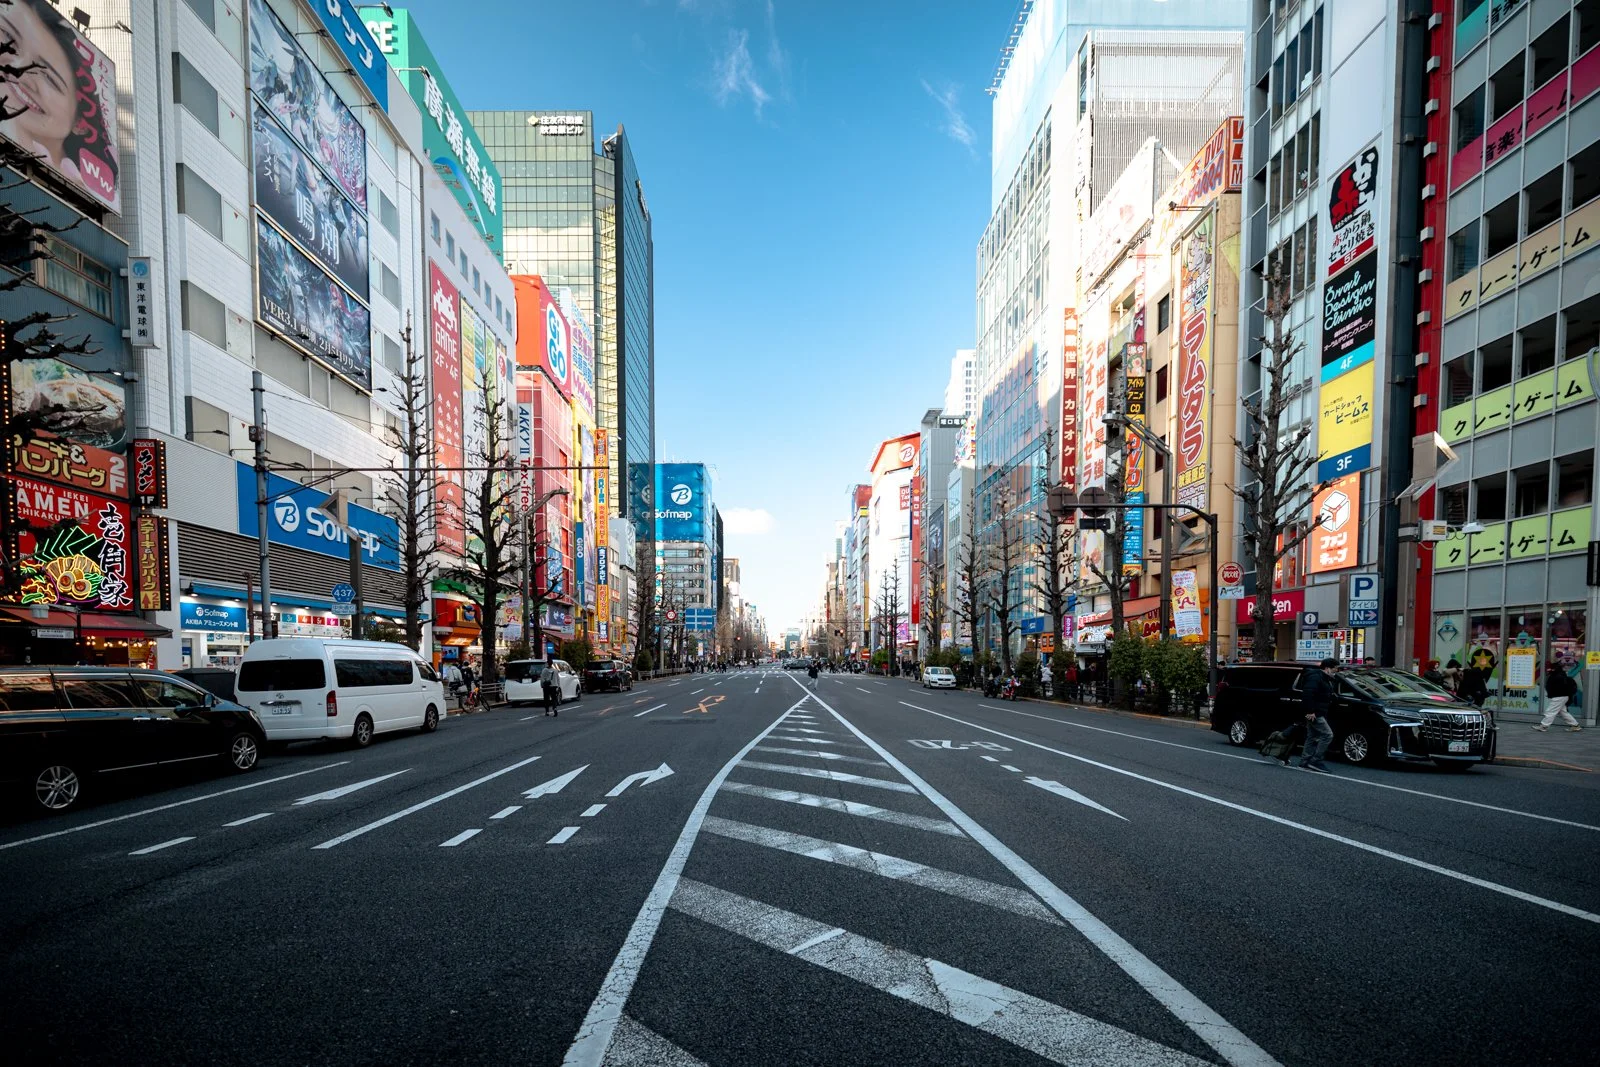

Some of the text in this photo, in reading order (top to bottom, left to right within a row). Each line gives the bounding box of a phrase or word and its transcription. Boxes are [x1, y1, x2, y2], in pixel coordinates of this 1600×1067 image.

[366, 20, 393, 53] SE
[540, 116, 583, 125] 住友不動産
[1480, 88, 1575, 162] 音楽ゲーム
[423, 75, 497, 216] 廣瀬無線
[1204, 128, 1224, 169] DVD
[1332, 209, 1371, 249] 赤から鍋
[1328, 222, 1375, 262] セセリ焼き
[1343, 248, 1357, 265] 5F
[1459, 226, 1591, 307] クレーンゲーム
[262, 295, 298, 331] VER3.1
[434, 321, 458, 362] GAME
[434, 350, 459, 381] 2F 4F
[1340, 356, 1353, 371] 4F
[1127, 377, 1145, 388] アイドル
[1181, 307, 1207, 467] ラムタラ
[1127, 390, 1144, 400] アニメ
[1324, 395, 1363, 418] カードショップ
[1130, 403, 1141, 413] CD
[1335, 402, 1369, 425] ビームス
[1454, 380, 1582, 436] クレーンゲーム
[519, 406, 530, 446] AKKY
[137, 449, 154, 493] ラーメン
[1126, 432, 1143, 488] DVD
[1336, 454, 1352, 472] 3F
[109, 456, 126, 493] 2F
[16, 479, 55, 494] OHAMA
[63, 491, 89, 503] IEKEI
[16, 488, 90, 521] AMEN
[140, 495, 154, 504] 1F
[654, 508, 692, 521] Sofmap
[1320, 531, 1347, 549] ファン
[1448, 529, 1576, 563] クレーンゲーム
[140, 518, 156, 591] ステーキ&ハンバーグ
[1319, 548, 1348, 566] キューブ
[333, 589, 352, 597] 437
[1354, 577, 1373, 597] P
[152, 593, 160, 609] 2F
[1351, 601, 1377, 609] ダイビル
[204, 608, 229, 620] Sofmap
[1350, 610, 1364, 621] IN
